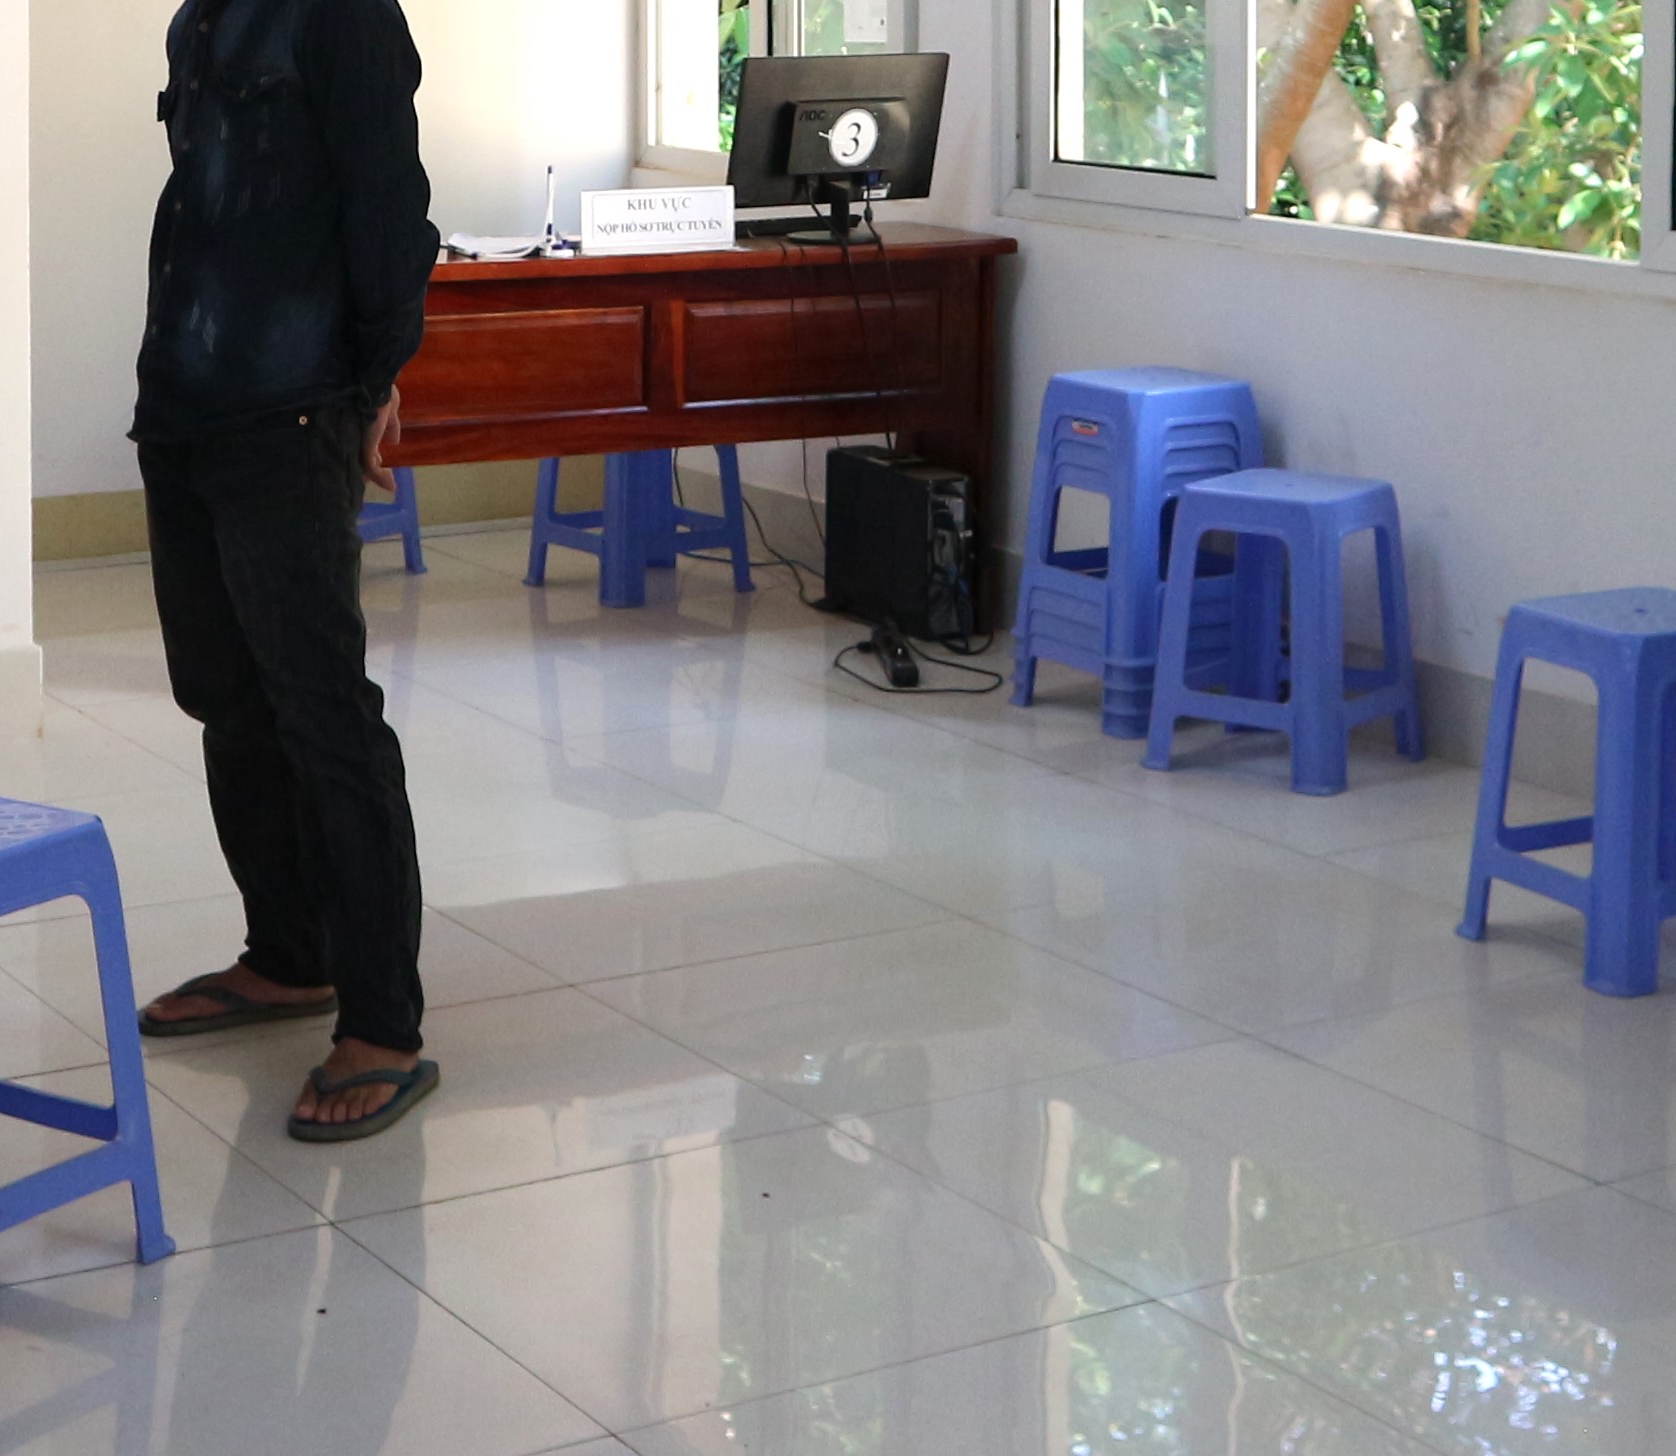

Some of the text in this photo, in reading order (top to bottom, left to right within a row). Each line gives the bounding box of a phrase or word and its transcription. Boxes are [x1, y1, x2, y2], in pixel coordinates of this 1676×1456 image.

[841, 122, 861, 157] 3
[627, 197, 692, 212] KHU VỰC
